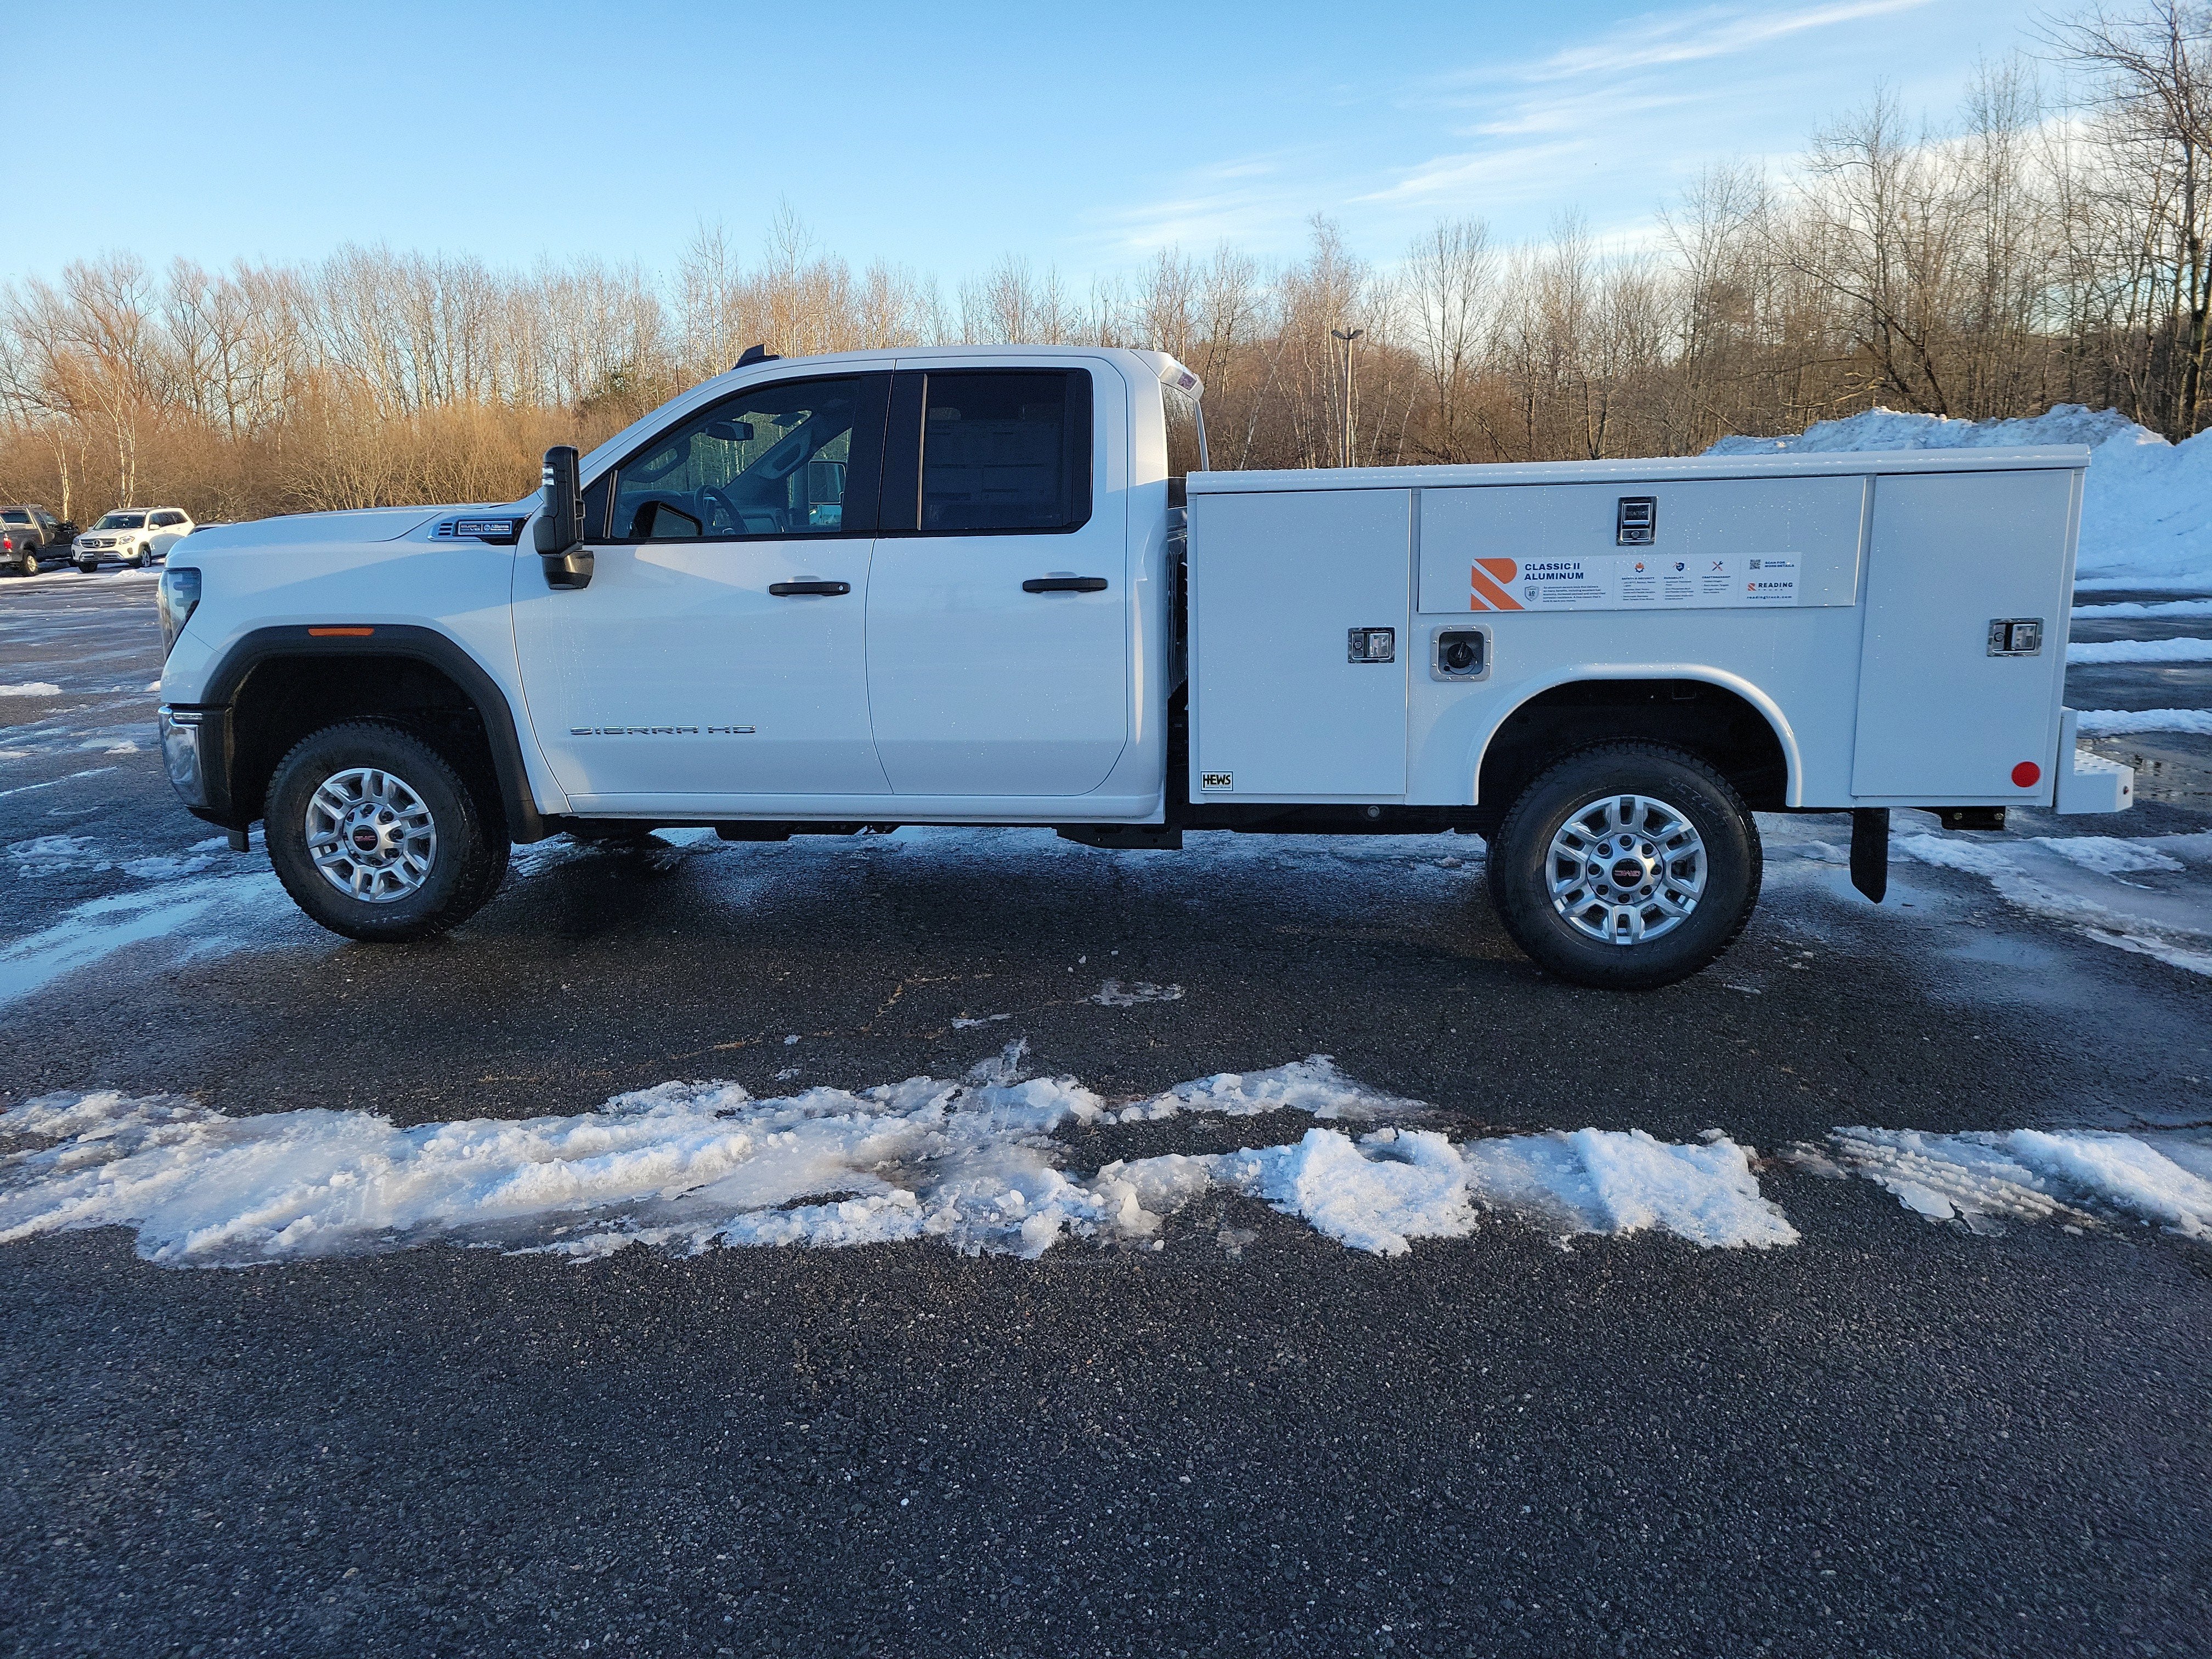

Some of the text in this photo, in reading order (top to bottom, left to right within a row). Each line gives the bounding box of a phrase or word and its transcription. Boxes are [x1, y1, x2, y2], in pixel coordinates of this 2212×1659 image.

[1524, 572, 1584, 580] ALUMINUM
[571, 724, 756, 735] SIERRA HD
[1203, 774, 1231, 788] HEWS
